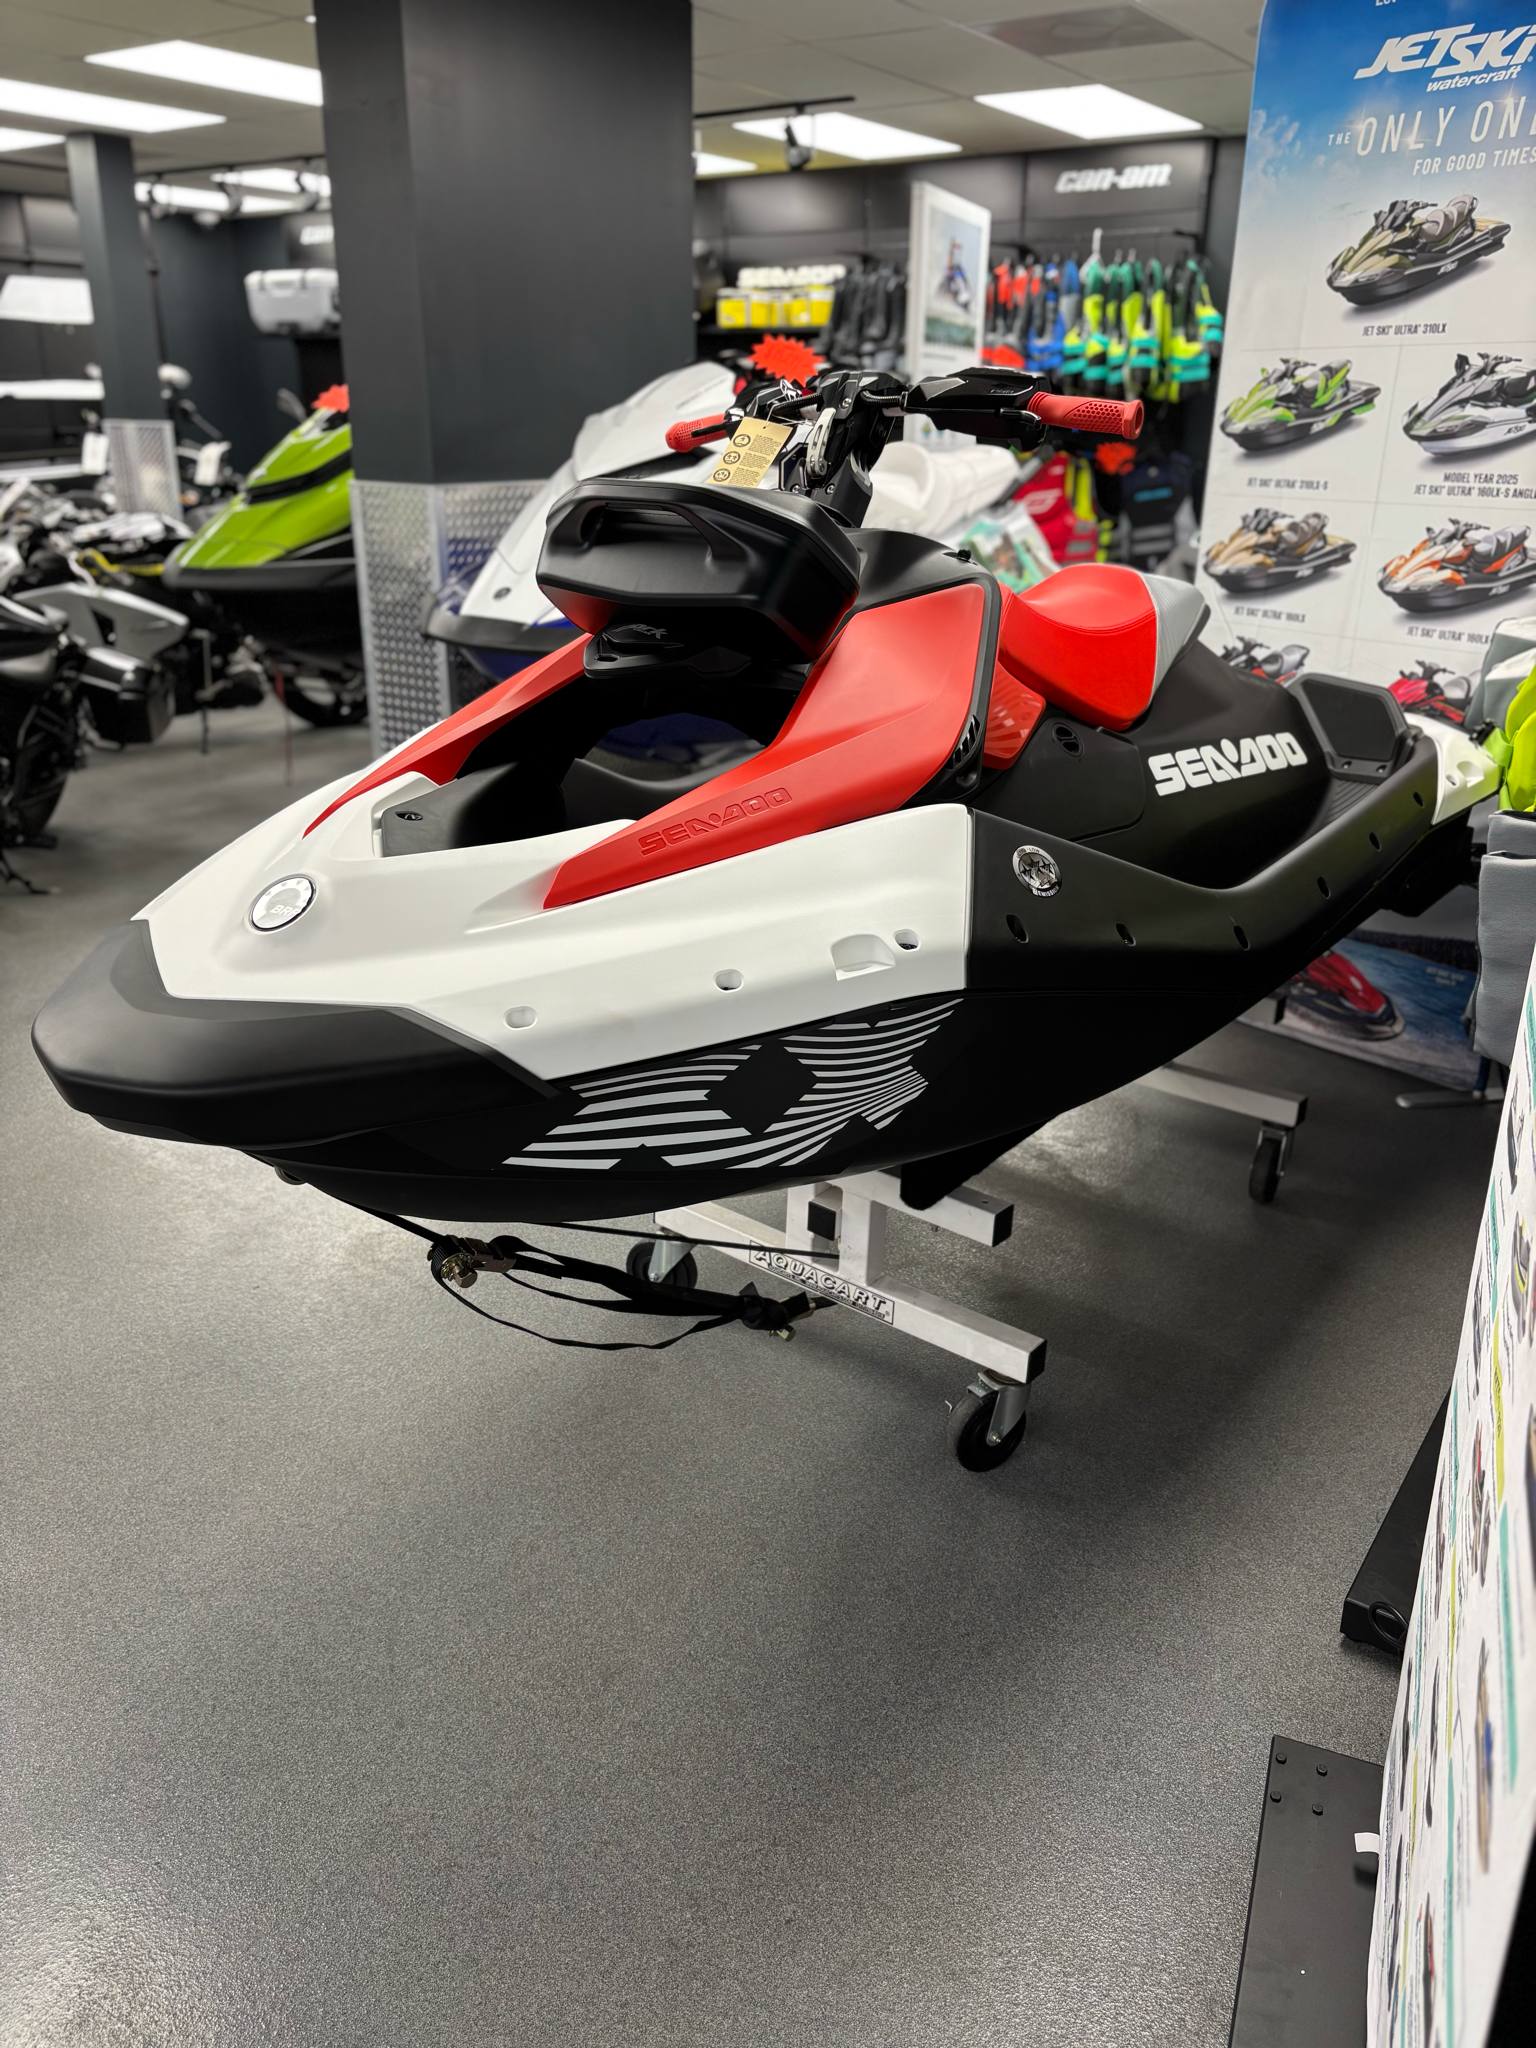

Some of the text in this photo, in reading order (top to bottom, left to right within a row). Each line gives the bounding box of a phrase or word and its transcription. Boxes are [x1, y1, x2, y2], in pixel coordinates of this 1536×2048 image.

[1426, 65, 1522, 92] watercraft
[1328, 131, 1352, 146] THE
[1357, 105, 1456, 156] ONLY
[1413, 158, 1441, 176] FOR
[1446, 152, 1486, 172] GOOD
[1362, 326, 1375, 336] JET
[1422, 322, 1447, 334] 310LX
[1414, 484, 1427, 495] JET
[1443, 472, 1519, 485] MODEL YEAR 2025
[755, 1249, 887, 1311] AQUACART
